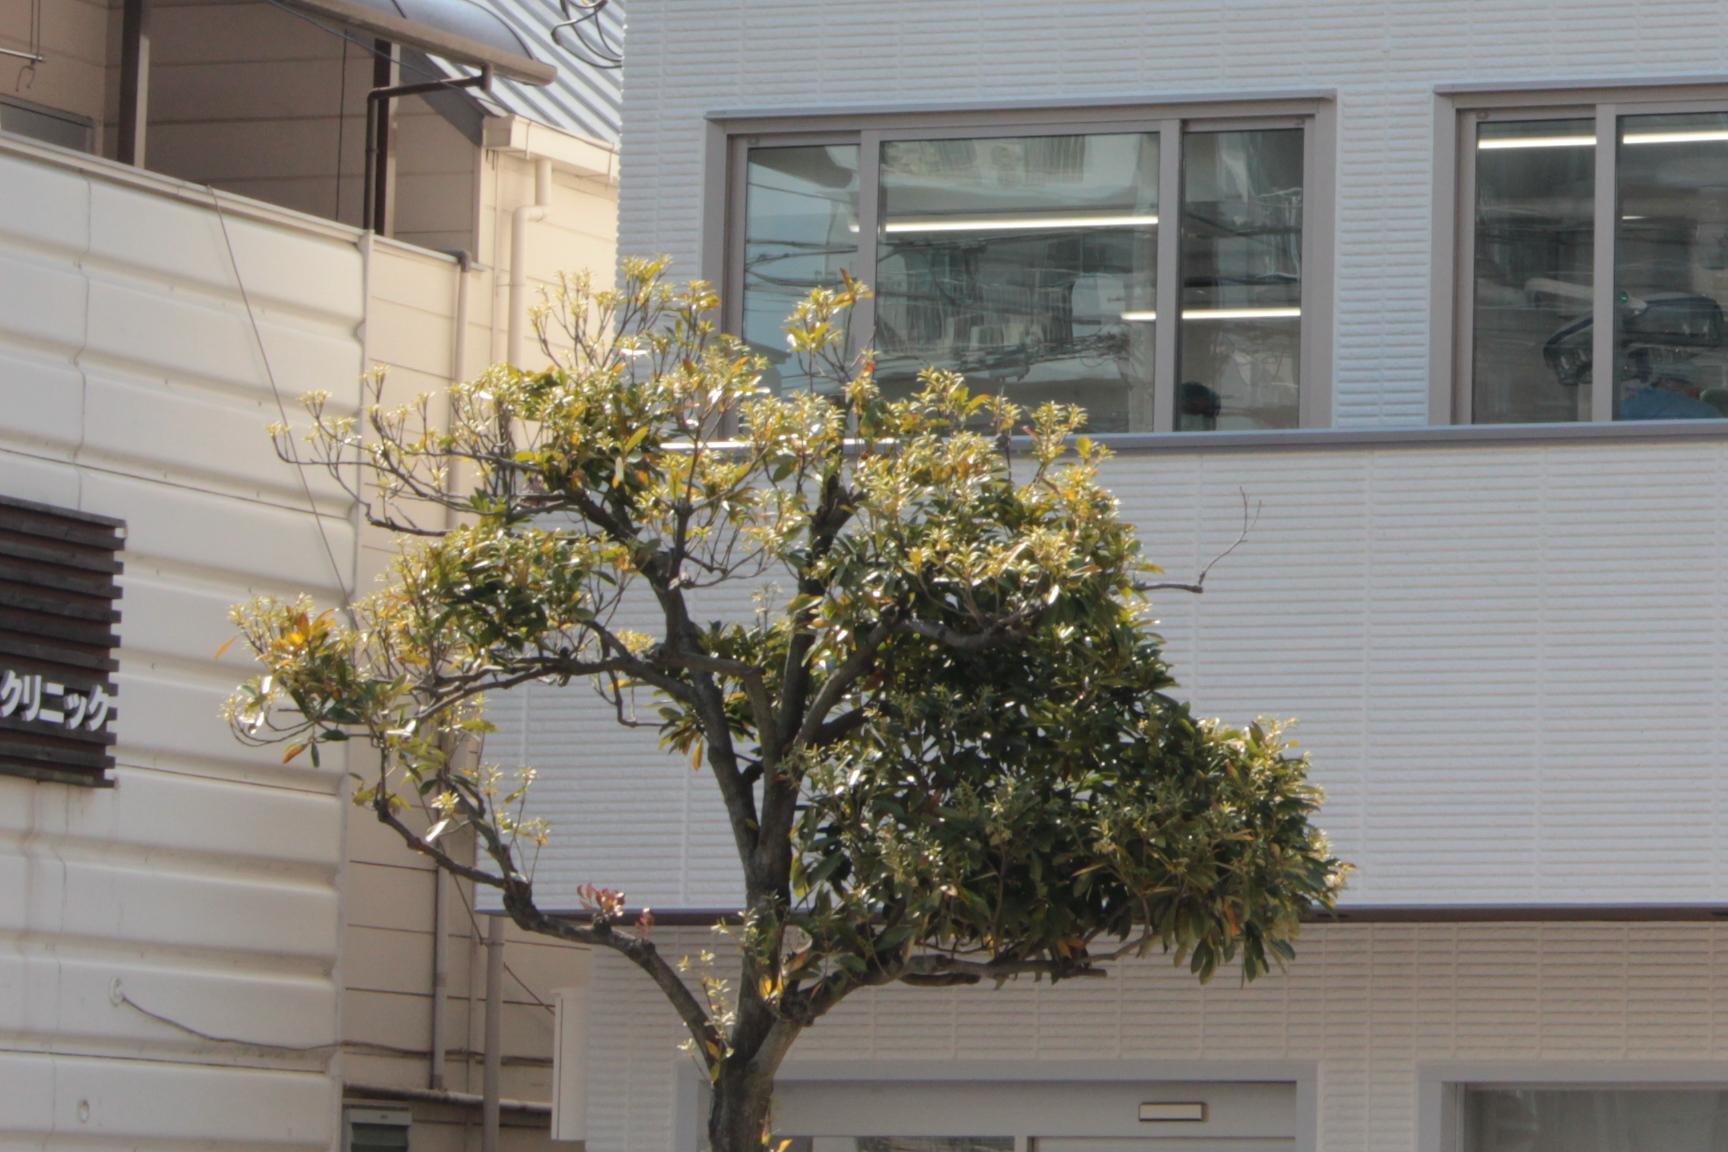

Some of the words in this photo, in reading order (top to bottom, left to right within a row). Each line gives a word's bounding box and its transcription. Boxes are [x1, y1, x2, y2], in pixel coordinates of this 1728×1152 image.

[0, 670, 109, 732] クリニック
